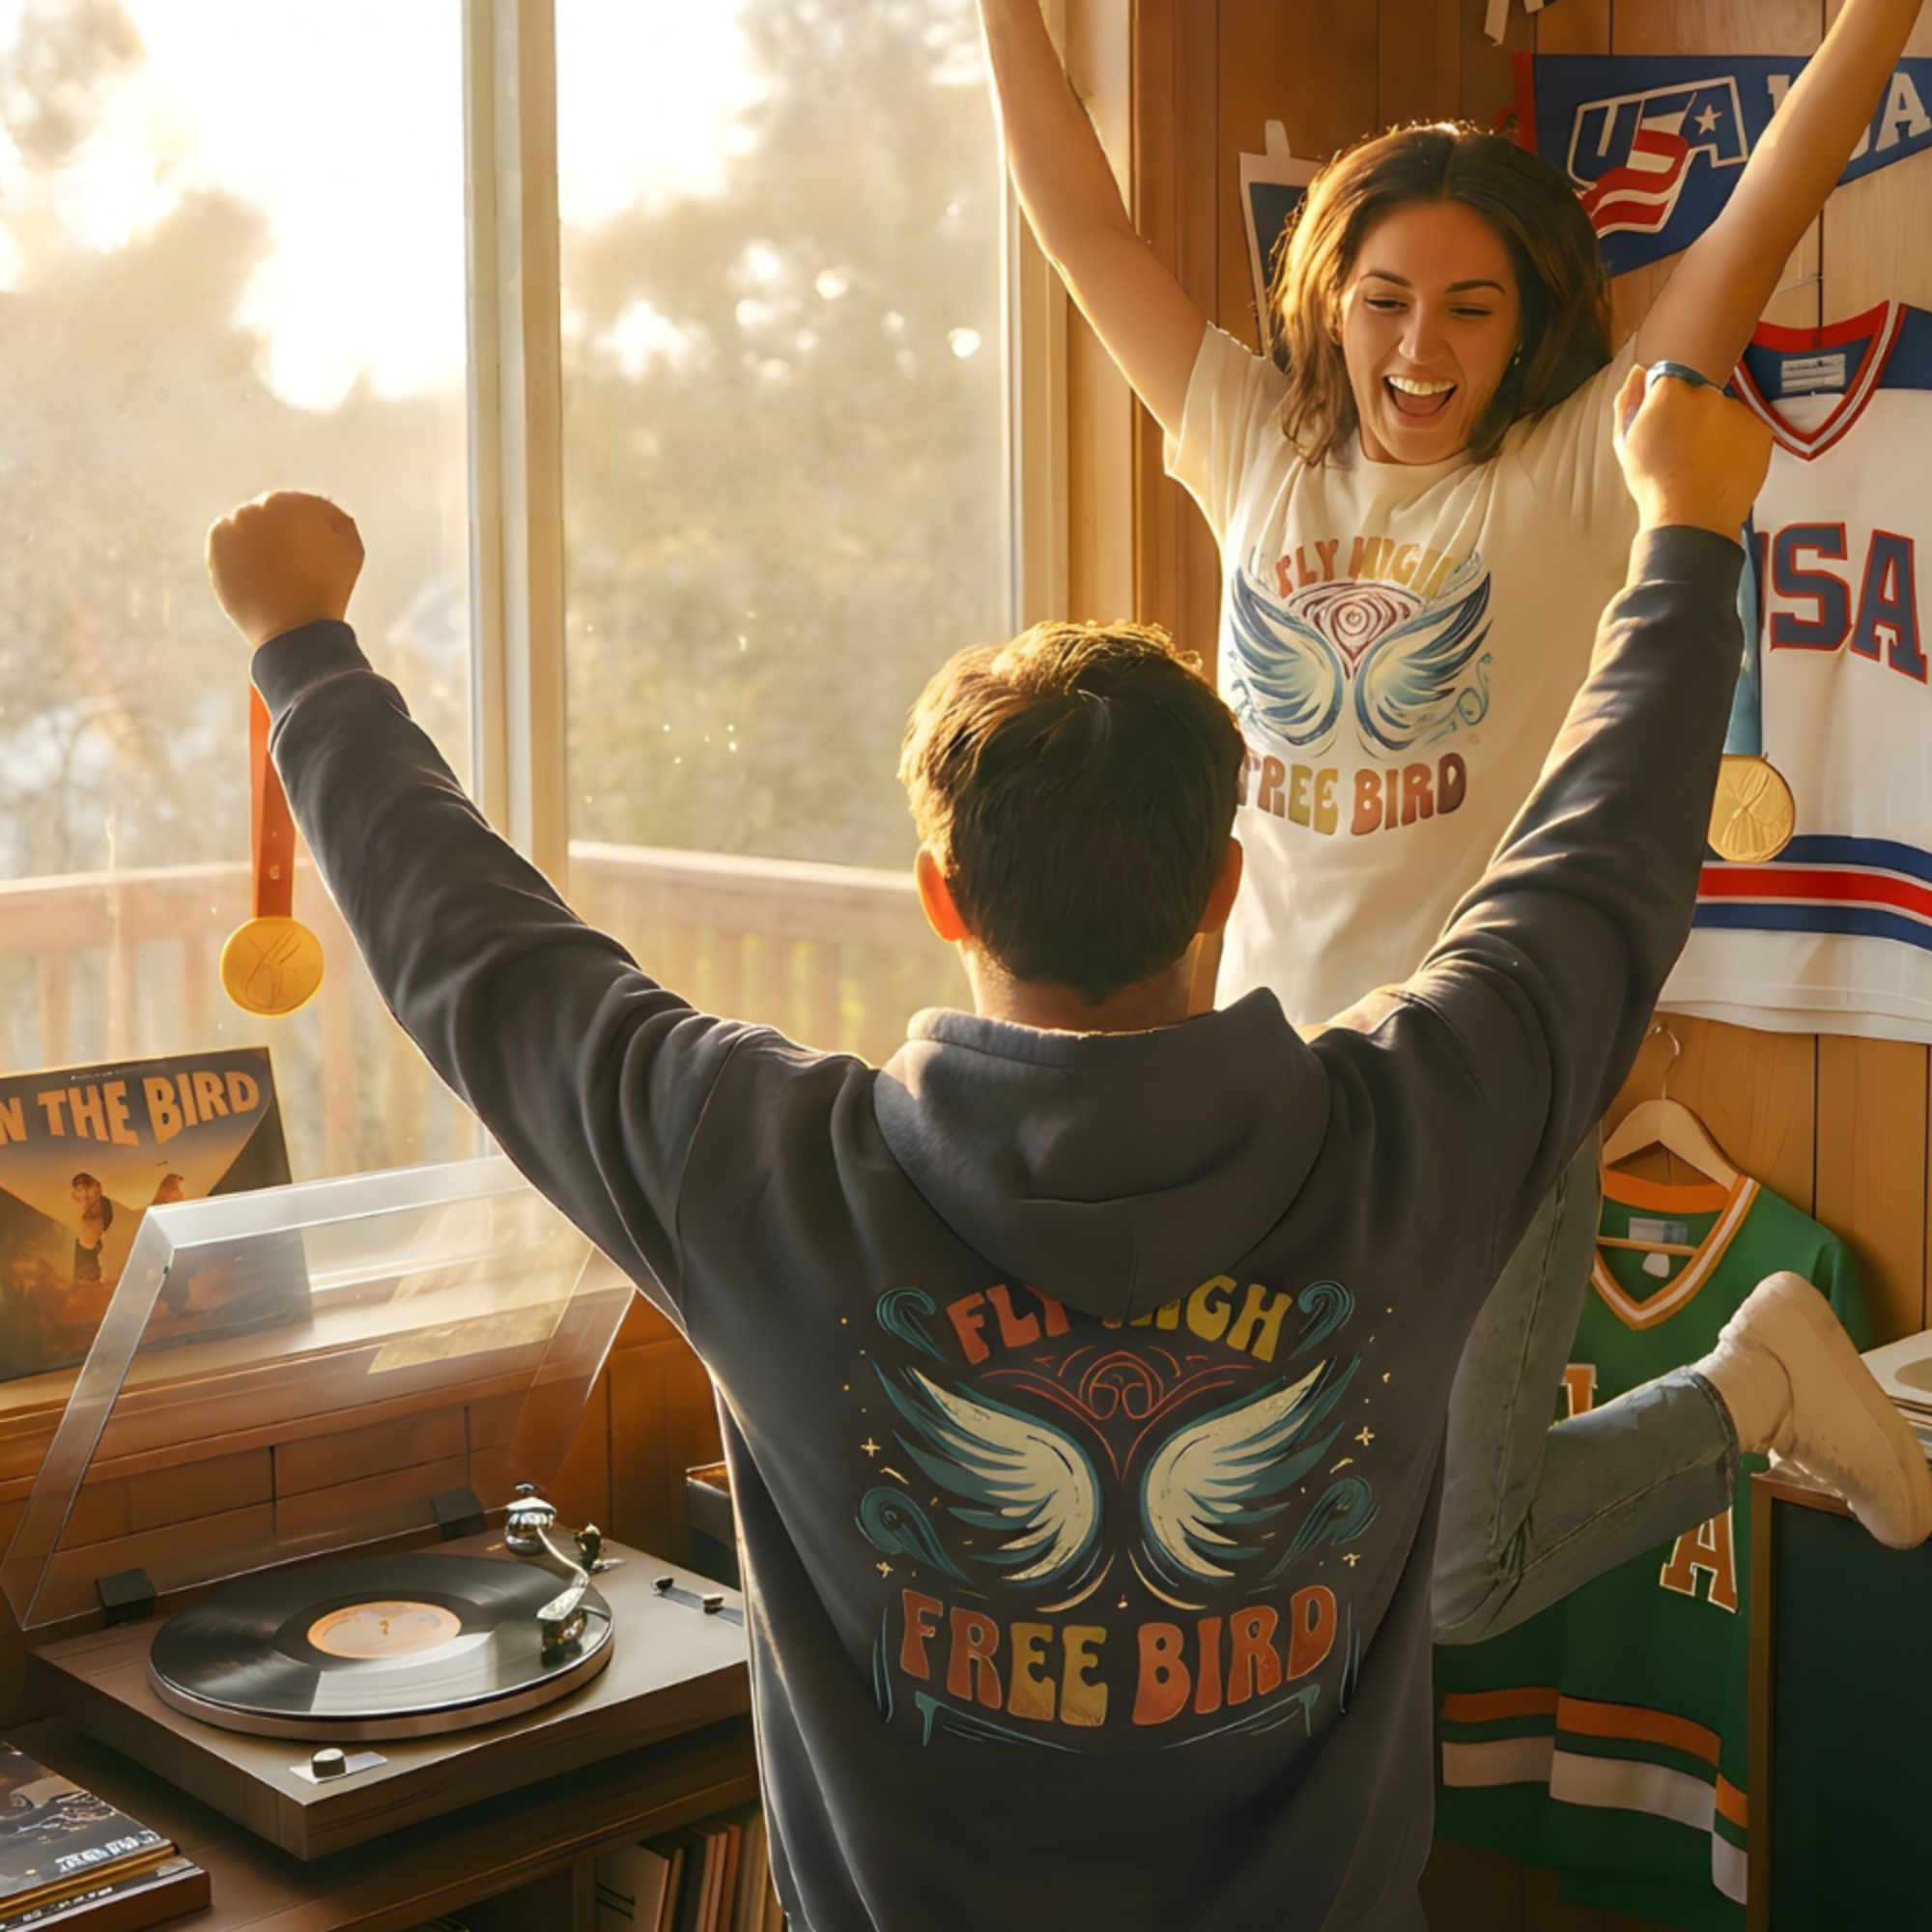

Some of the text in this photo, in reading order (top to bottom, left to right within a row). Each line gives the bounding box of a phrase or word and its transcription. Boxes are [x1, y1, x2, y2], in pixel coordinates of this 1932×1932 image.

[1755, 522, 1928, 684] SA
[1350, 753, 1466, 836] BIRD
[38, 1080, 140, 1147] THE
[143, 1071, 260, 1144] BIRD
[1102, 1274, 1293, 1362] GH
[900, 1585, 1337, 1726] FREE BIRD
